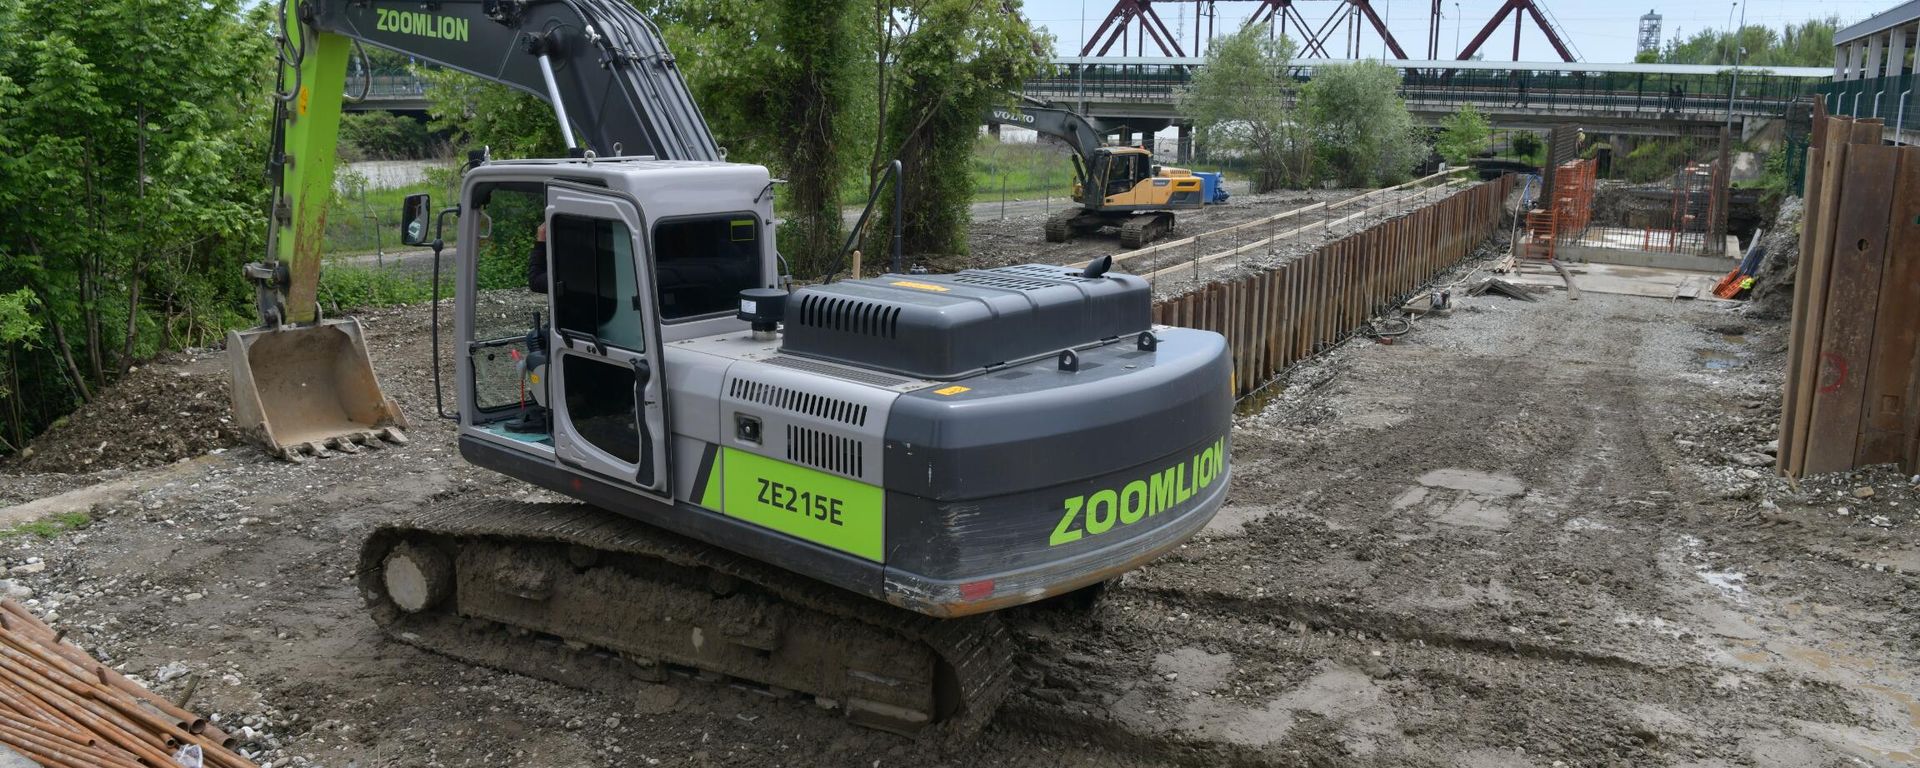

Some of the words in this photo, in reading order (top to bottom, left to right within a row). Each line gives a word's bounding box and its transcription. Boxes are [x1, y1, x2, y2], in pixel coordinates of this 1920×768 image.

[376, 8, 469, 42] ZOOMLION
[757, 477, 843, 526] ZE215E
[1049, 434, 1225, 547] ZOOMLION
